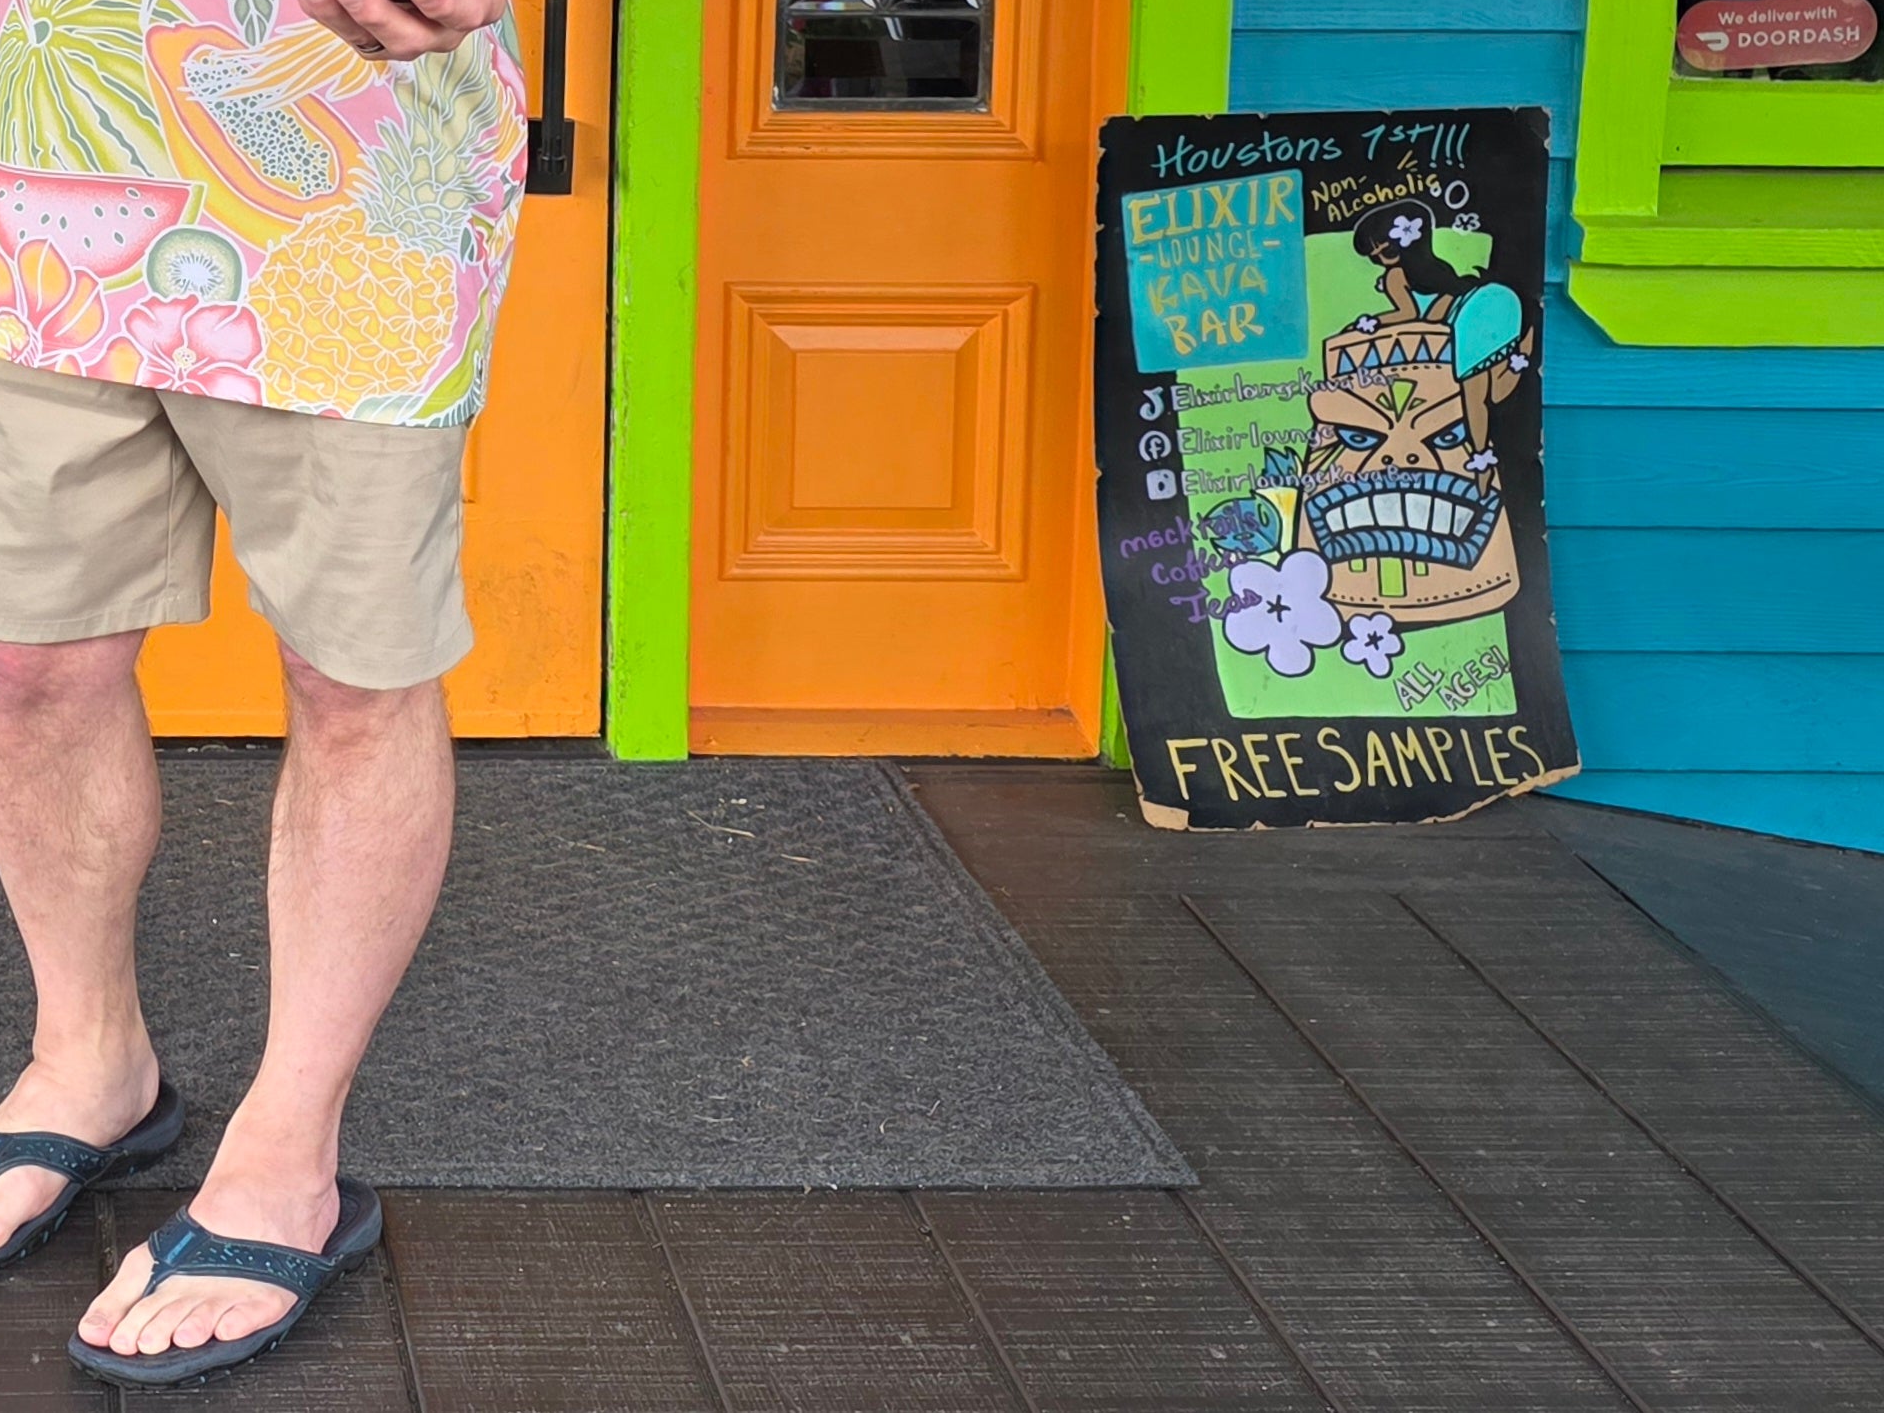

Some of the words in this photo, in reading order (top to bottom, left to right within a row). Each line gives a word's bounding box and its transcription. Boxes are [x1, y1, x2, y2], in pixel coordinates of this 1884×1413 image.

[1718, 11, 1744, 25] We
[1747, 9, 1800, 24] deliver
[1803, 6, 1837, 20] with
[1738, 25, 1861, 48] DOORDASH
[1151, 134, 1342, 178] Houstons
[1128, 174, 1297, 245] ELIXIR
[1311, 175, 1367, 211] Non-
[1147, 264, 1269, 317] KAVA
[1163, 303, 1265, 356] BAR
[1169, 588, 1263, 624] Teas
[1393, 661, 1445, 712] ALL
[1435, 644, 1512, 712] AGES!
[1166, 732, 1320, 802] FREE
[1316, 725, 1545, 793] SAMPLES
